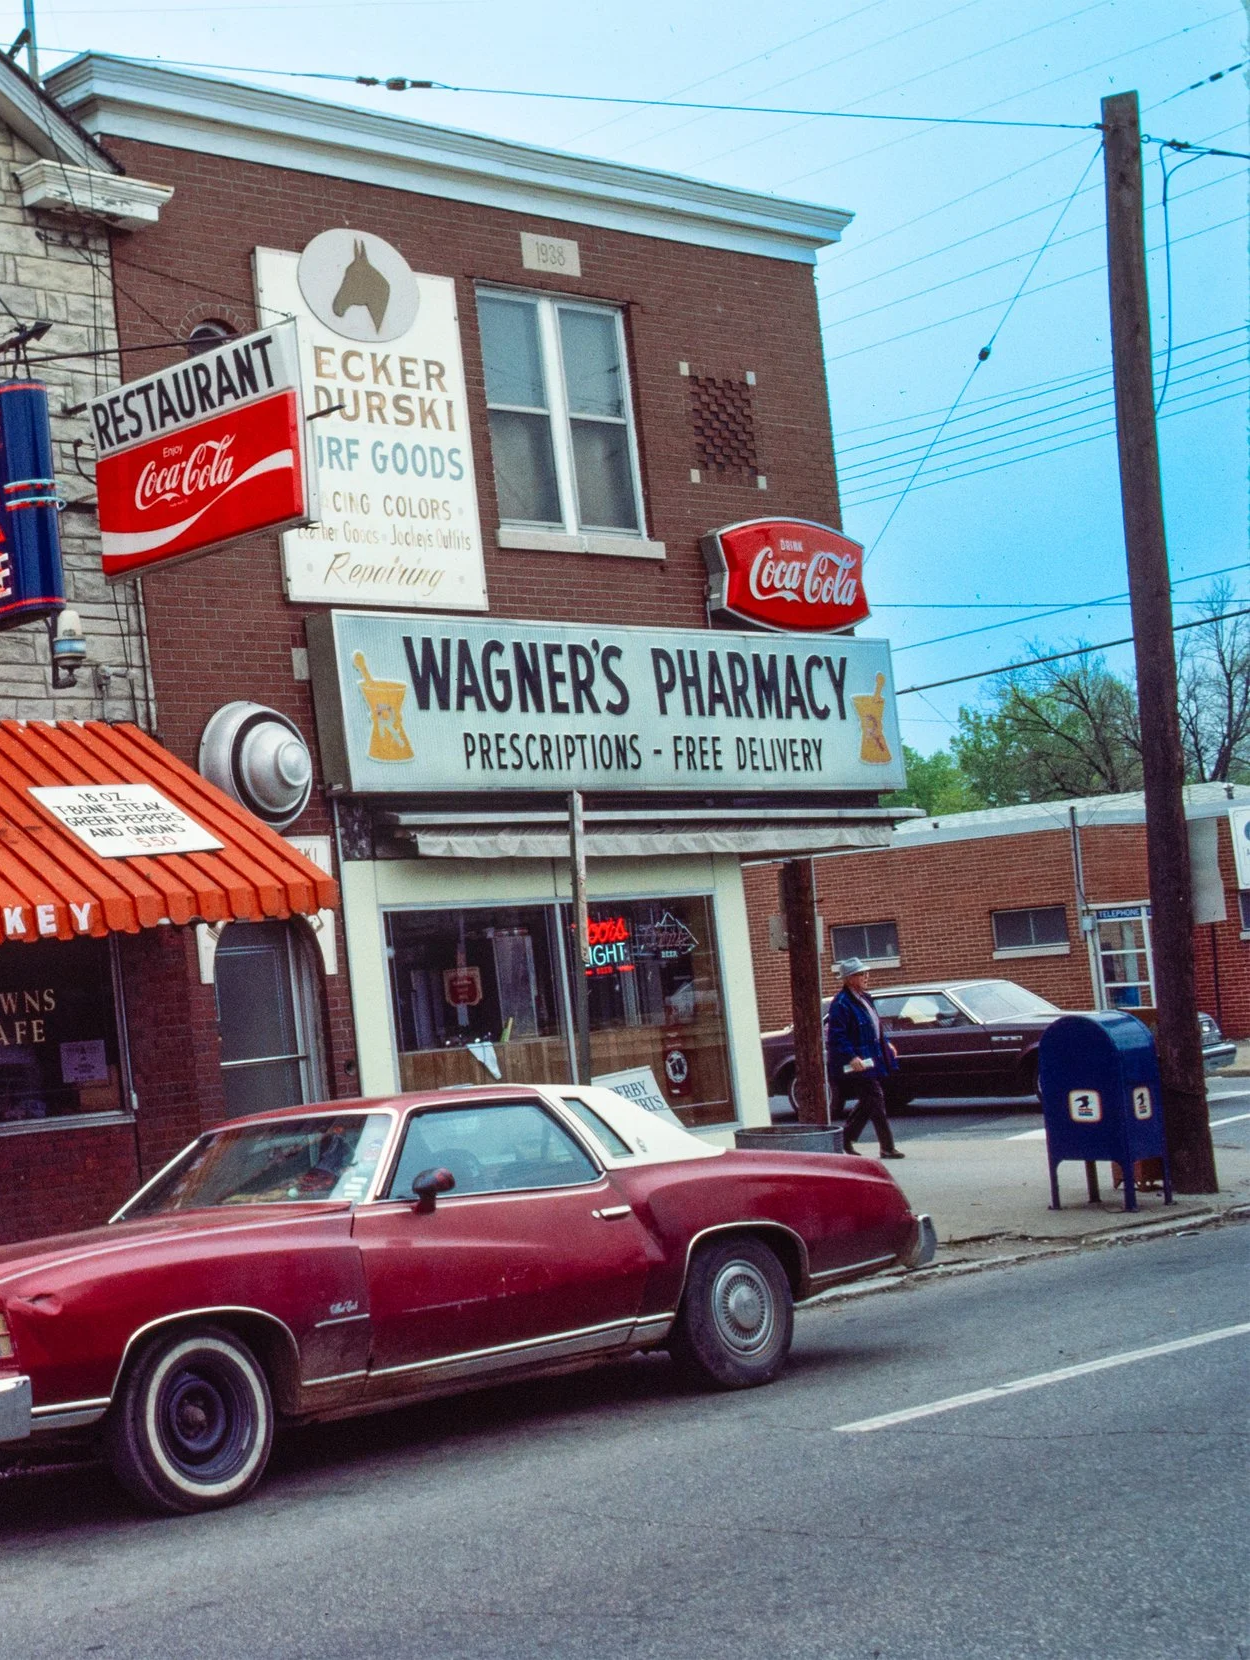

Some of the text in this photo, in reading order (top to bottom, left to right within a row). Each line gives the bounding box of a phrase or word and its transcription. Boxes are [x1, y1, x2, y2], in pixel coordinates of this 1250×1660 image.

[535, 241, 566, 266] 1938
[92, 335, 275, 451] RESTAURANT
[162, 443, 184, 459] Enjoy
[370, 439, 464, 482] GOODS
[134, 433, 237, 511] Coca-Cola
[383, 494, 452, 521] COLORS
[779, 538, 804, 553] DRINK
[323, 551, 446, 598] Repairing
[749, 546, 857, 607] Coca-Cola
[402, 635, 848, 721] WAGNER'S PHARMACY
[462, 732, 642, 771] PRESCRIPTIONS
[673, 735, 724, 771] FREE
[736, 736, 823, 772] DELIVERY
[78, 792, 98, 803] 16
[112, 801, 166, 814] STEAK
[65, 812, 186, 827] GREEN PEPPERS
[89, 823, 186, 838] AND ONIONS
[1098, 908, 1140, 919] TELEPHONE
[587, 917, 630, 945] oors
[585, 942, 626, 967] IGHT
